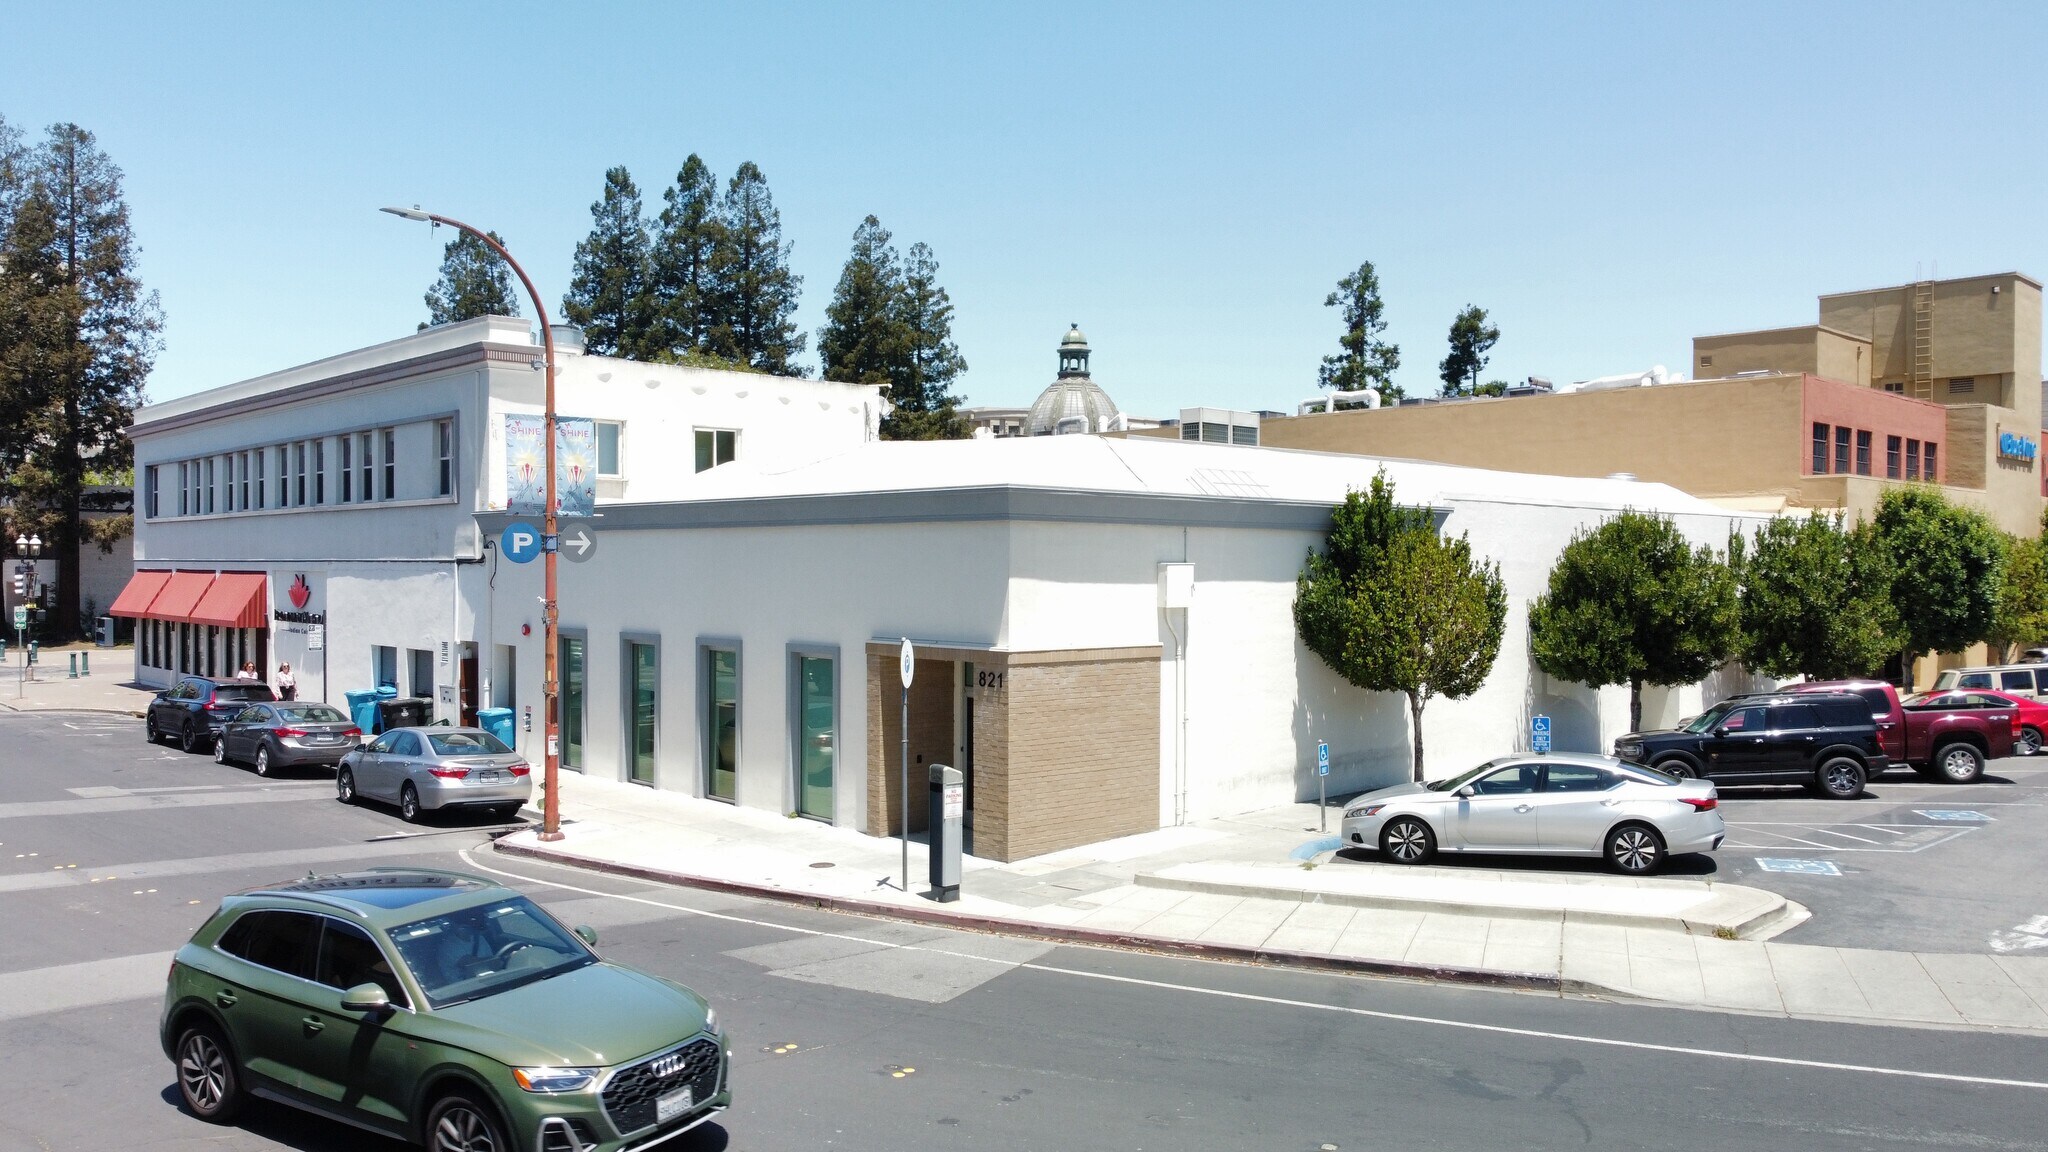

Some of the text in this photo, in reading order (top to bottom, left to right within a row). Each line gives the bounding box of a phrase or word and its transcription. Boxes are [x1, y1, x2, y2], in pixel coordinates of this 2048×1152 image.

[510, 426, 541, 436] SHINE
[560, 428, 589, 438] SHINE
[513, 533, 533, 553] P
[978, 671, 1003, 688] 821
